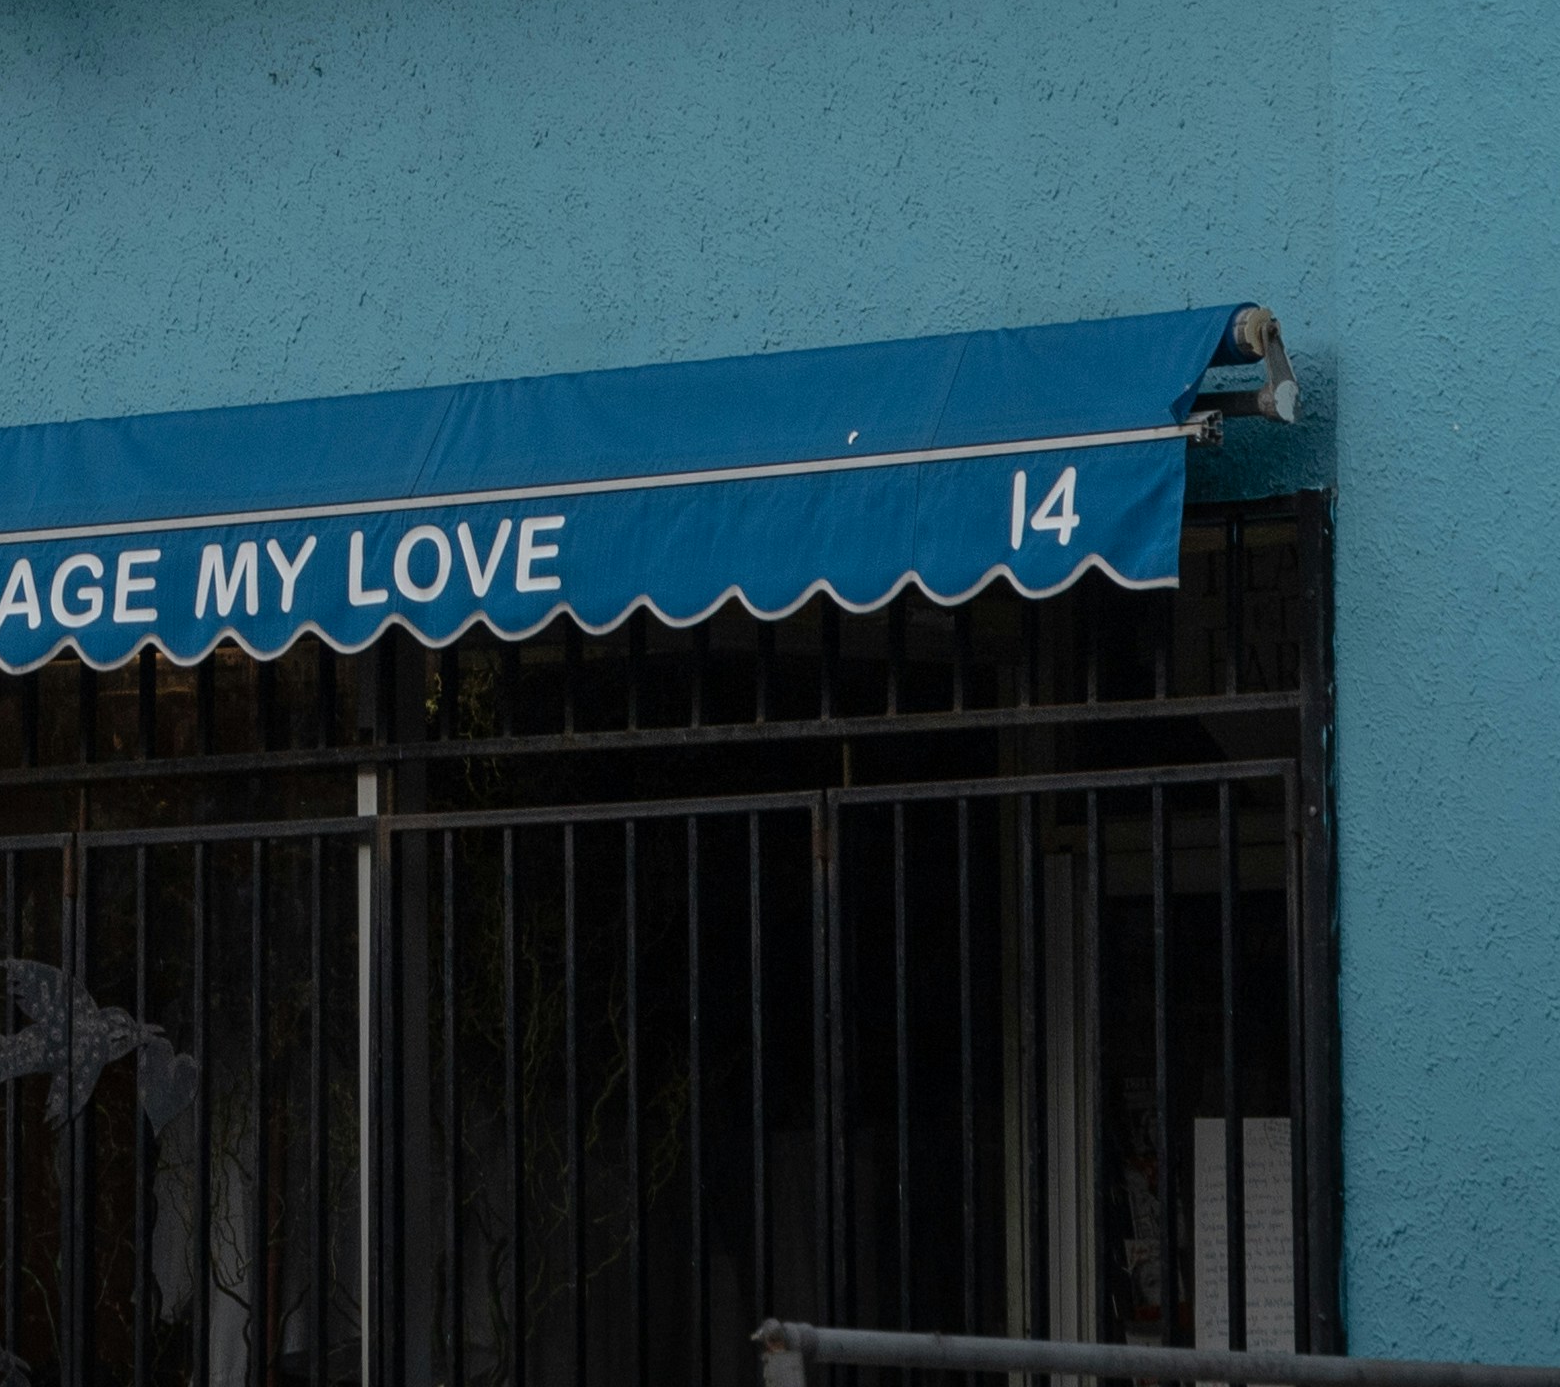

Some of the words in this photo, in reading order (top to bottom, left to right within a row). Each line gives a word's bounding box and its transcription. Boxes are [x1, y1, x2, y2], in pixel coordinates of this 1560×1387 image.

[1010, 465, 1082, 551] 14
[194, 534, 318, 620] MY
[347, 514, 568, 607] LOVE
